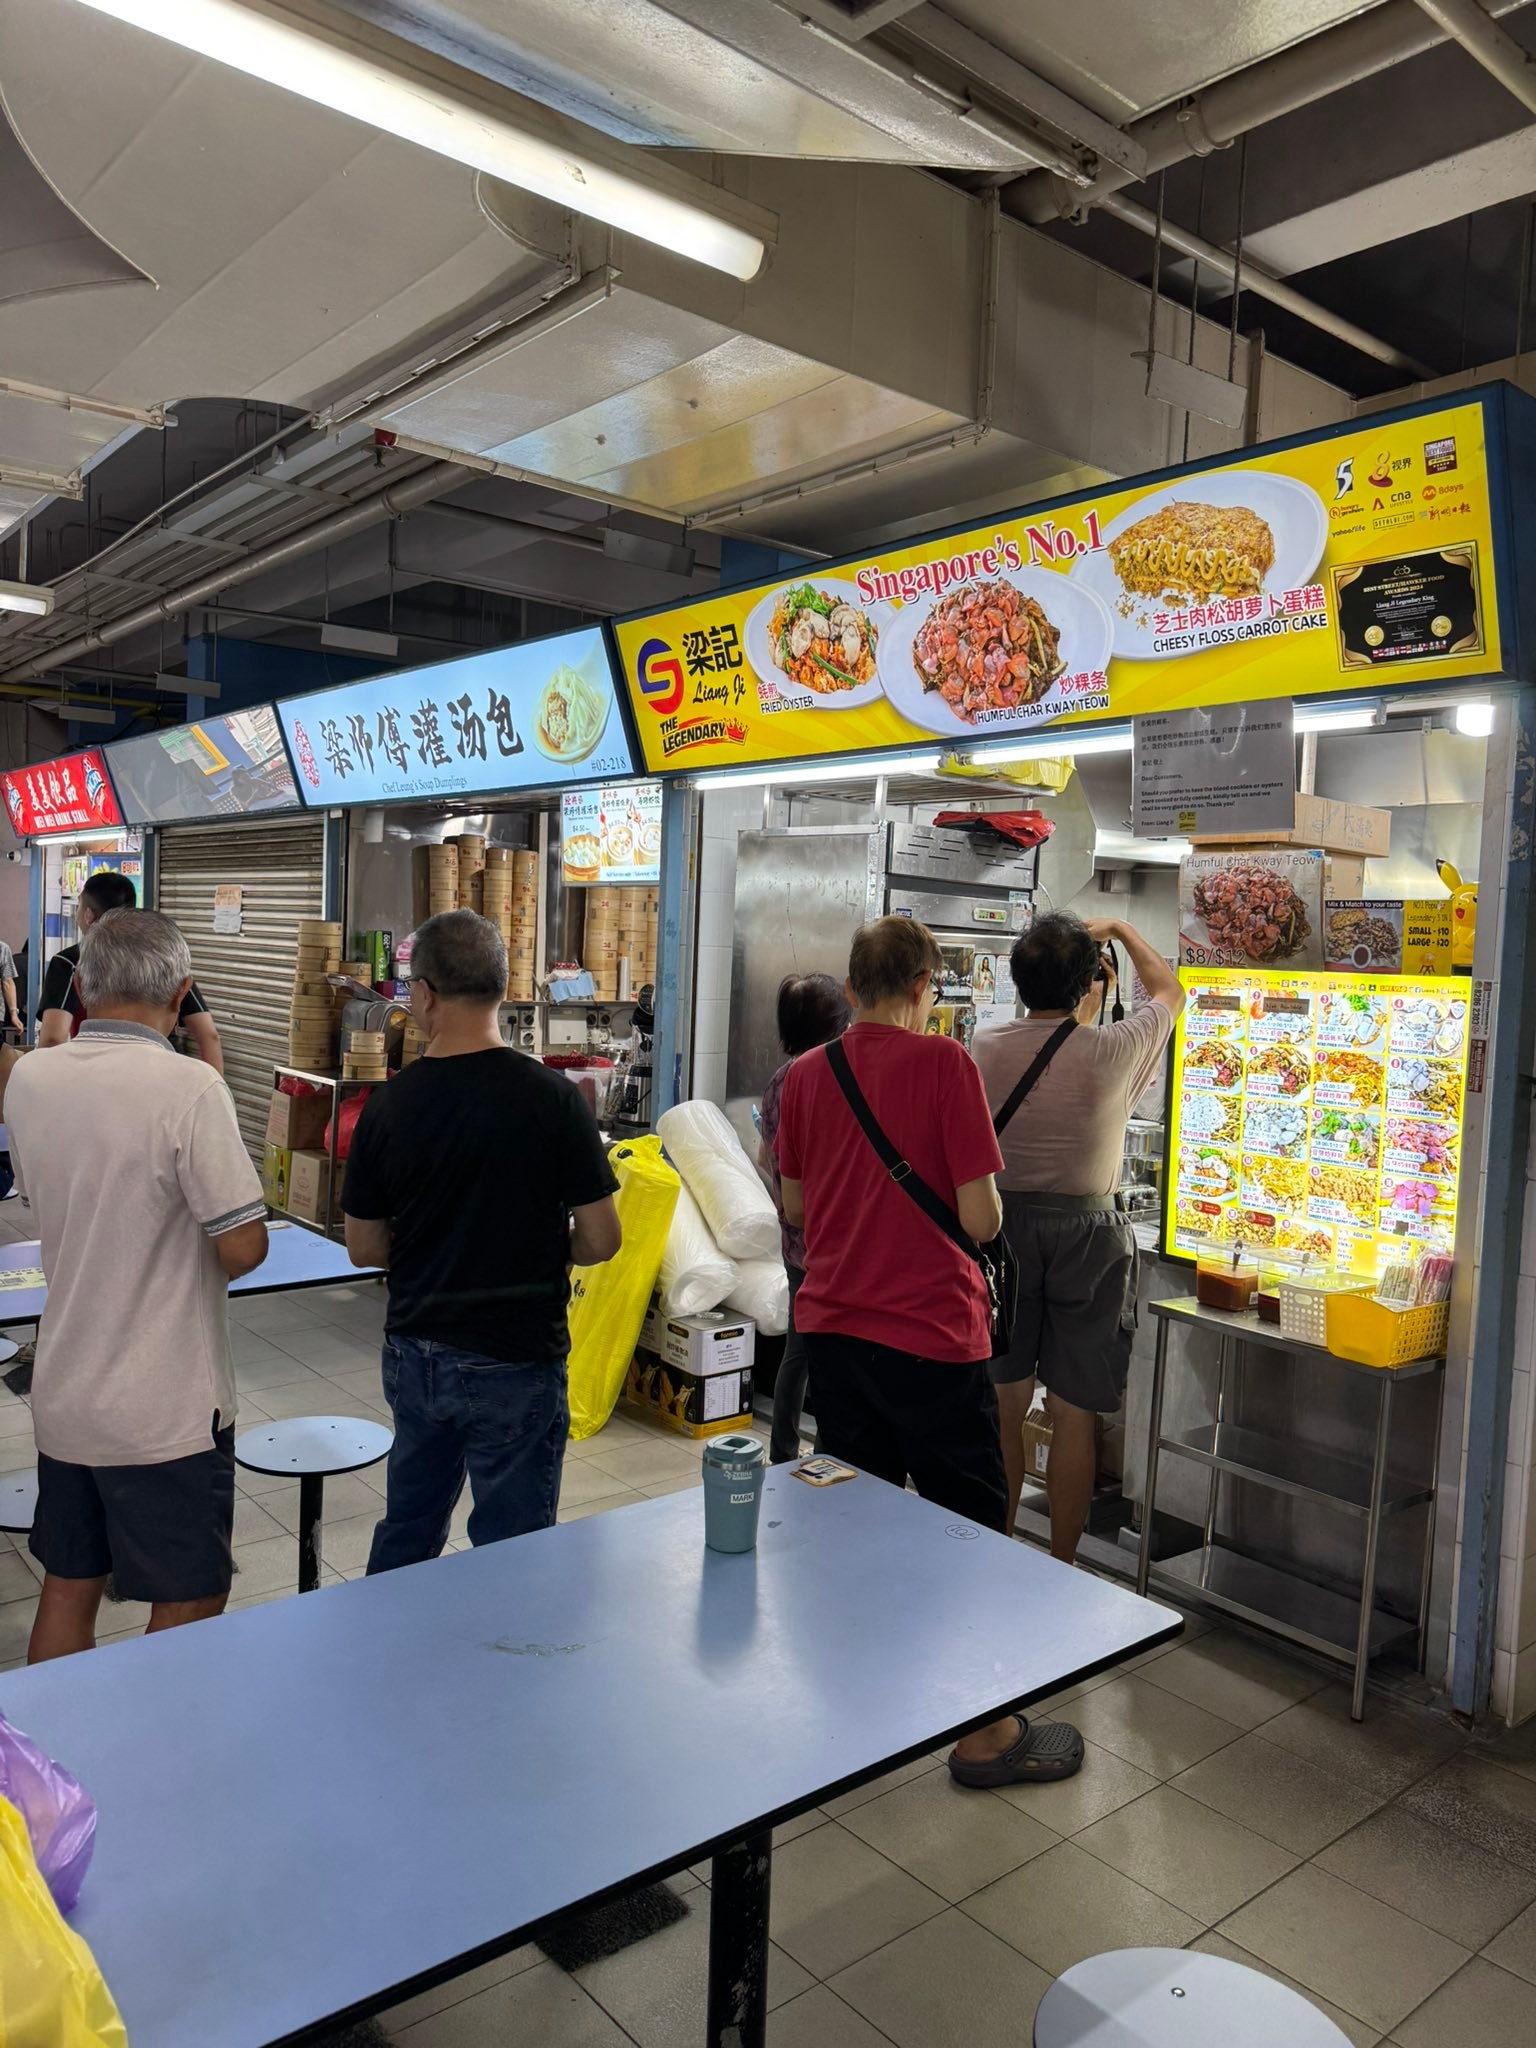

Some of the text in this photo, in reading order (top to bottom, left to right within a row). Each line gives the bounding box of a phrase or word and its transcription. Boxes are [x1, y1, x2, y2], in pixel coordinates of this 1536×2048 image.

[1392, 457, 1411, 471] 视界
[1391, 490, 1411, 502] cna
[1438, 484, 1464, 494] 8days
[857, 511, 1105, 605] Singapore's No.1
[1153, 585, 1326, 634] 芝士肉松胡萝卜蛋糕
[1154, 613, 1327, 652] CHEESY FLOSS CARROT CAKE
[682, 624, 743, 676] 梁記
[1059, 671, 1108, 695] 炒粿条
[693, 681, 730, 705] Liang
[761, 696, 815, 714] FRIED OYSTER
[977, 695, 1110, 723] HUMFUL CHAR KWAY TEOW
[319, 688, 524, 779] 梁师傅灌汤包
[660, 717, 678, 735] THE
[662, 721, 726, 752] LEGENDARY
[591, 756, 626, 772] #02-218
[382, 776, 467, 795] Chef Leung's Soup Dumplings
[1169, 789, 1184, 797] prefer
[1261, 781, 1283, 790] oysters
[1180, 795, 1191, 803] fully
[1192, 794, 1212, 802] cooked,
[1213, 792, 1230, 801] kindly
[1172, 804, 1183, 812] glad
[56, 813, 72, 826] DRINK
[72, 809, 90, 823] STALL
[1156, 820, 1169, 828] Liang
[1186, 855, 1224, 867] Humful
[1253, 855, 1282, 868] Kway
[1286, 854, 1316, 866] Teow
[1372, 902, 1386, 910] your
[1407, 914, 1435, 923] Legendary
[1438, 927, 1449, 936] $10
[1436, 938, 1449, 947] $20
[1186, 947, 1247, 966] $8/$12
[1472, 989, 1482, 1025] 8286 2303
